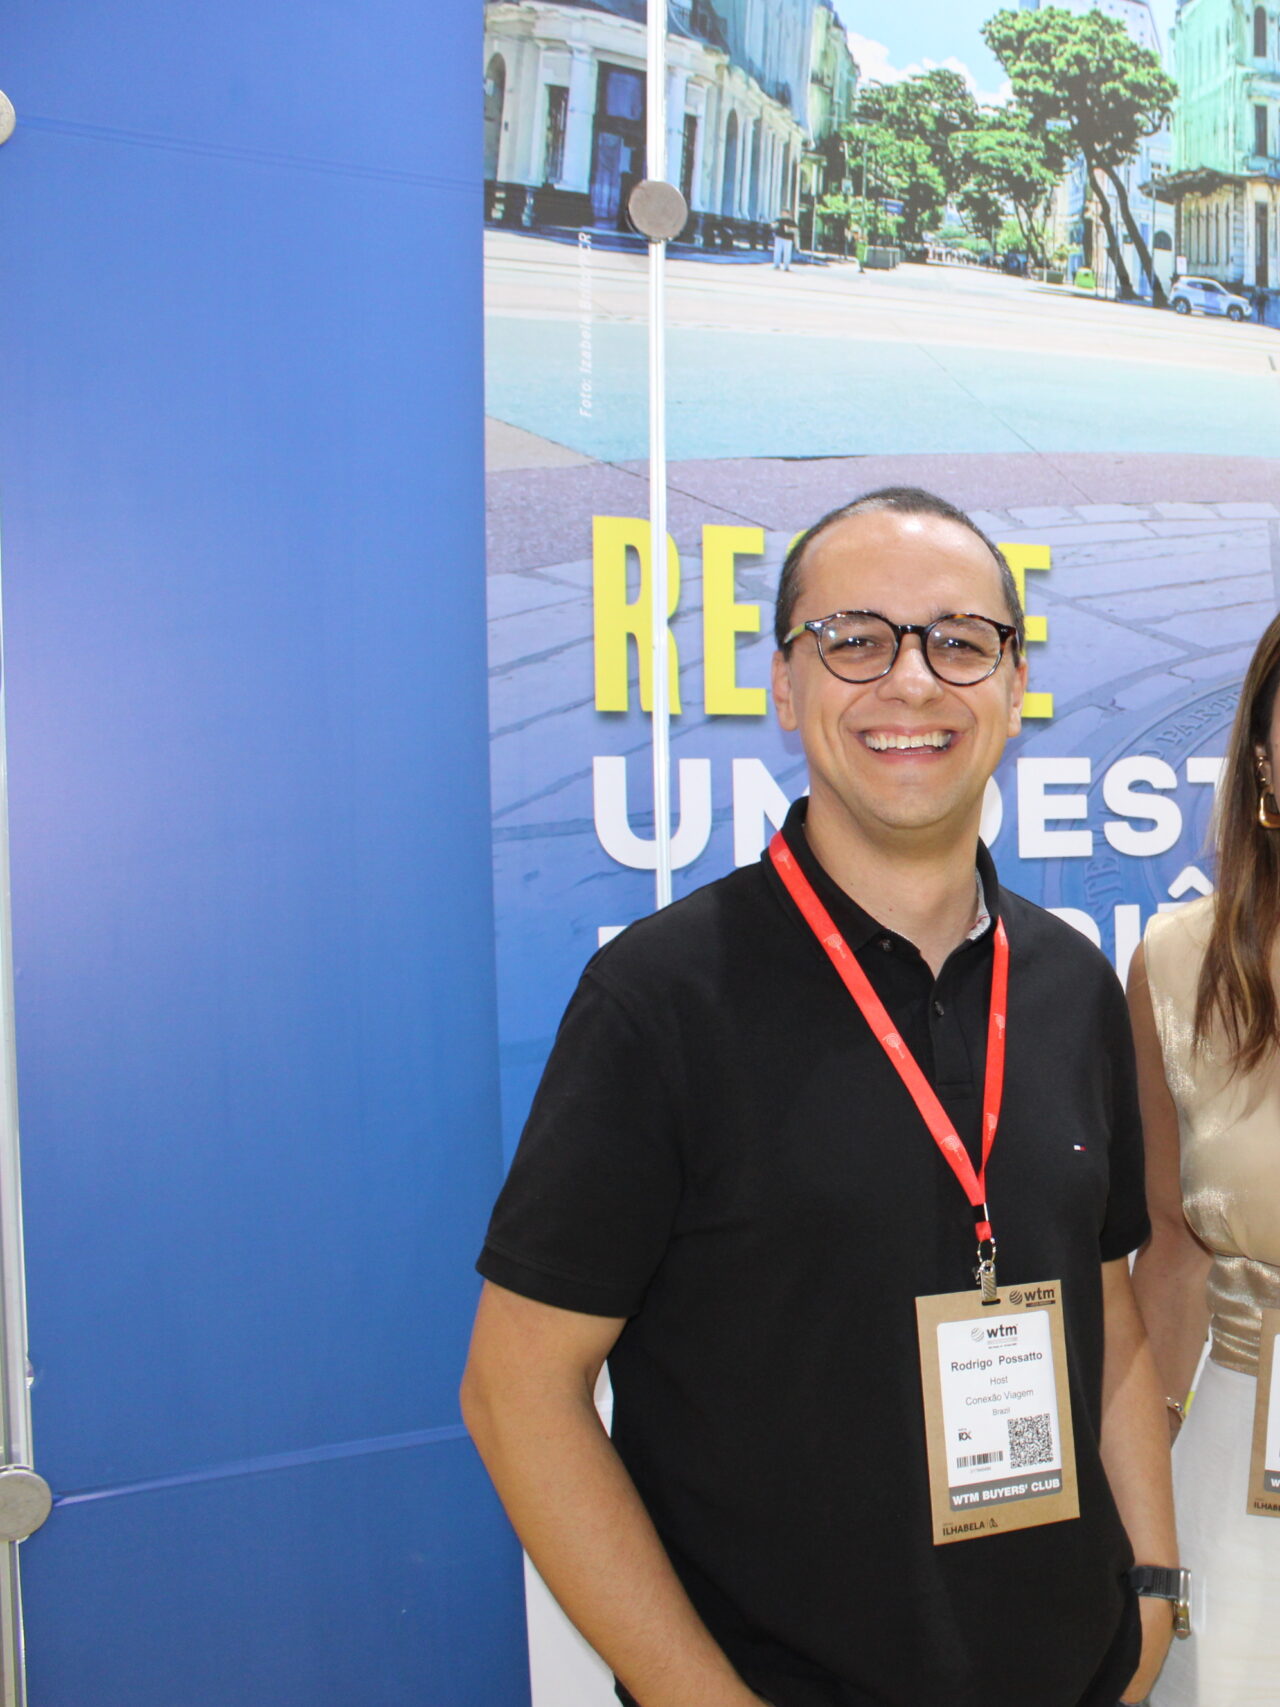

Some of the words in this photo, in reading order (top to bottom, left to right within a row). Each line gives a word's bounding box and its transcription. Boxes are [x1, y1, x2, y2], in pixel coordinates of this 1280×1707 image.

[579, 378, 592, 417] Foto:
[1024, 1287, 1056, 1302] wtm
[986, 1324, 1018, 1338] wtm
[951, 1358, 993, 1372] Rodrigo
[999, 1352, 1043, 1366] Possatto
[990, 1376, 1008, 1386] Host
[965, 1393, 1003, 1406] Conexão
[1004, 1389, 1034, 1401] Viagem
[992, 1407, 1011, 1416] Brazil
[952, 1492, 980, 1506] WTM
[982, 1484, 1029, 1500] BUYERS'
[1031, 1478, 1060, 1492] CLUB
[943, 1521, 985, 1536] ILHABELA
